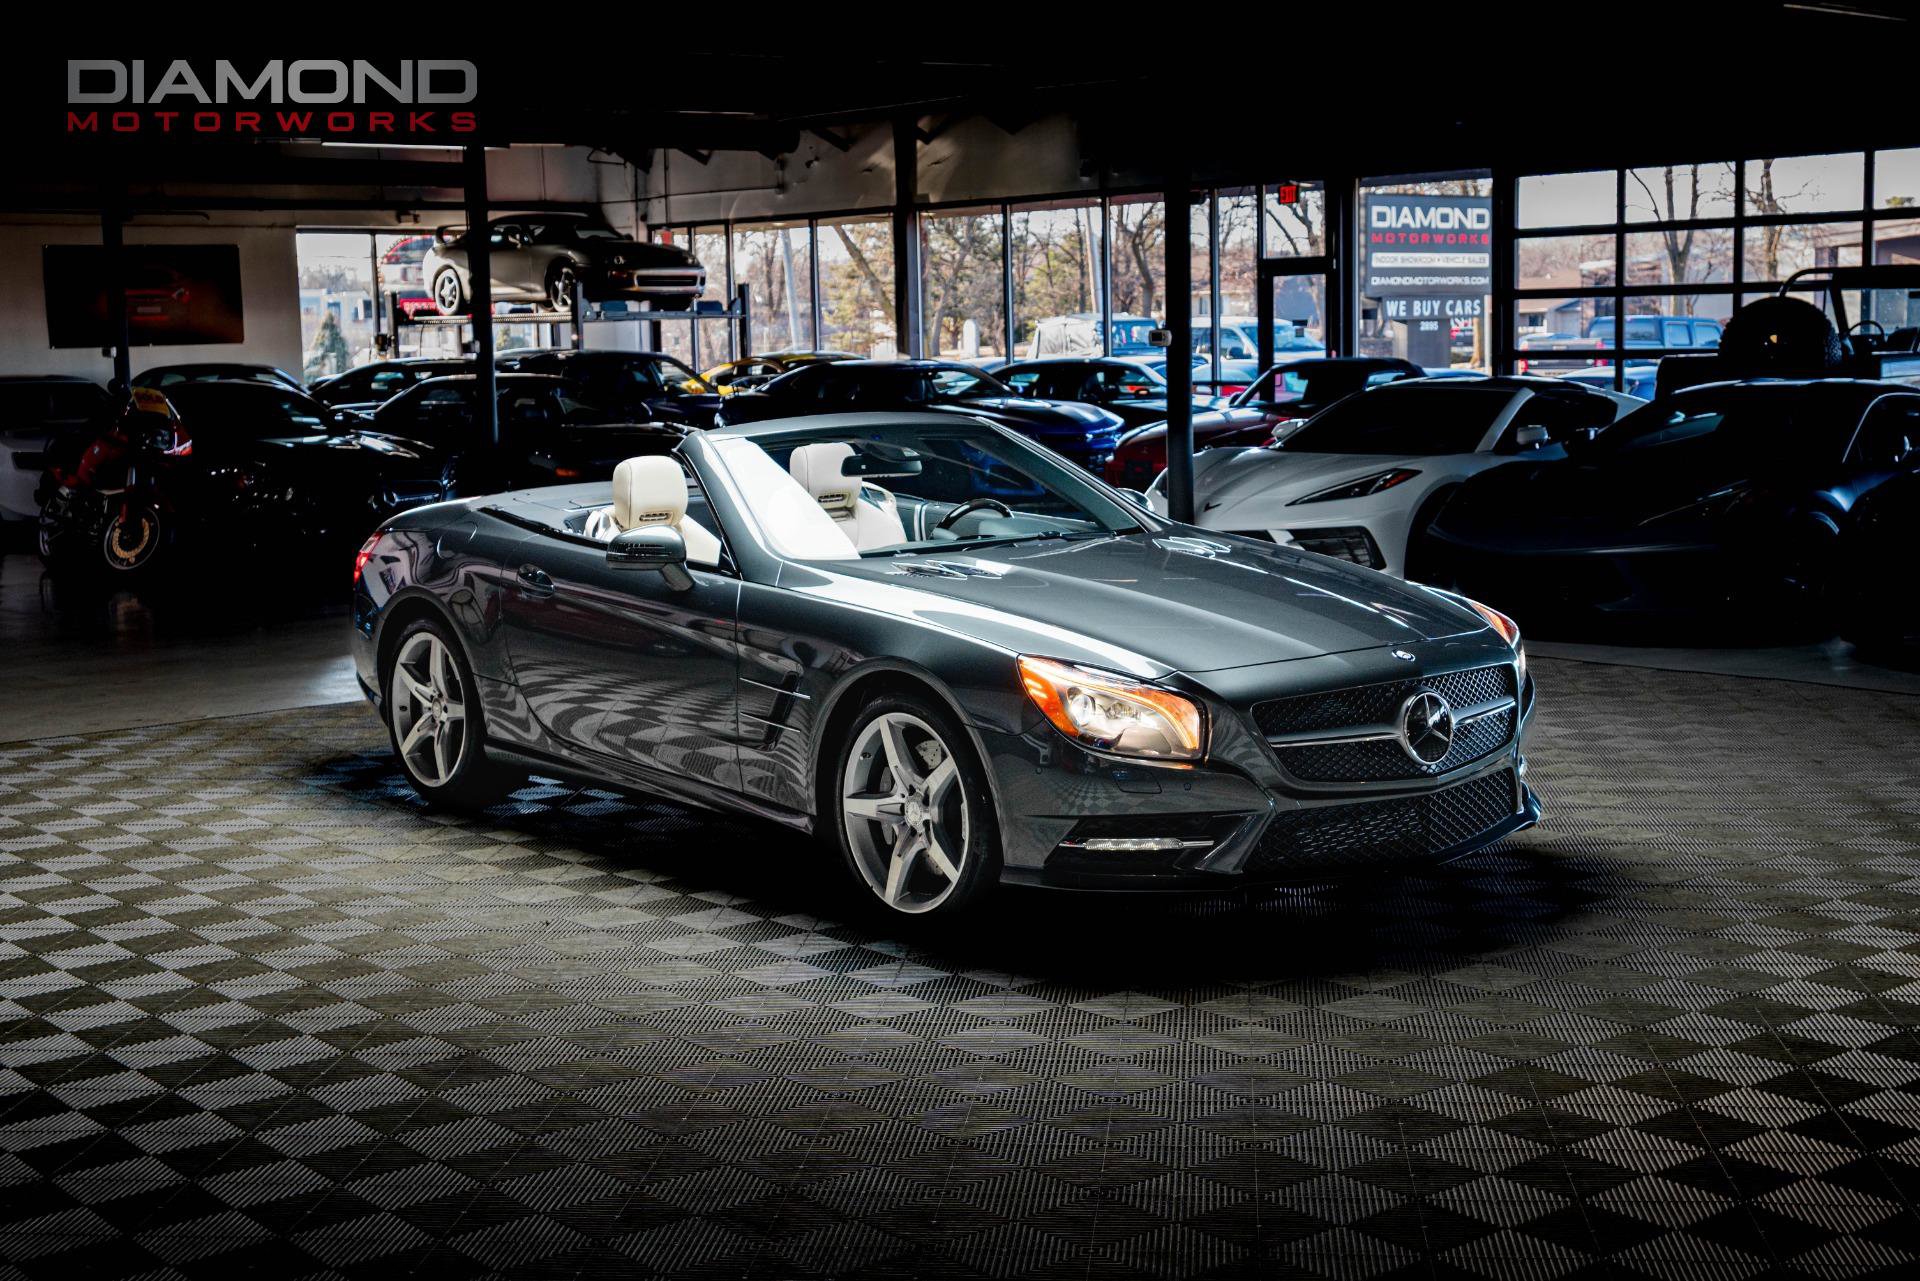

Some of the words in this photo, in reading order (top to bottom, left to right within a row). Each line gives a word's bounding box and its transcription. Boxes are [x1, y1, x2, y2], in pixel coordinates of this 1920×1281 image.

[1371, 205, 1490, 229] DIAMOND
[1371, 232, 1489, 245] MOTORWORKS
[1371, 276, 1489, 286] DIAMONDMOTORWORKS.COM
[1386, 300, 1406, 317] WE
[1413, 300, 1440, 316] BUY
[1445, 299, 1481, 316] CARS
